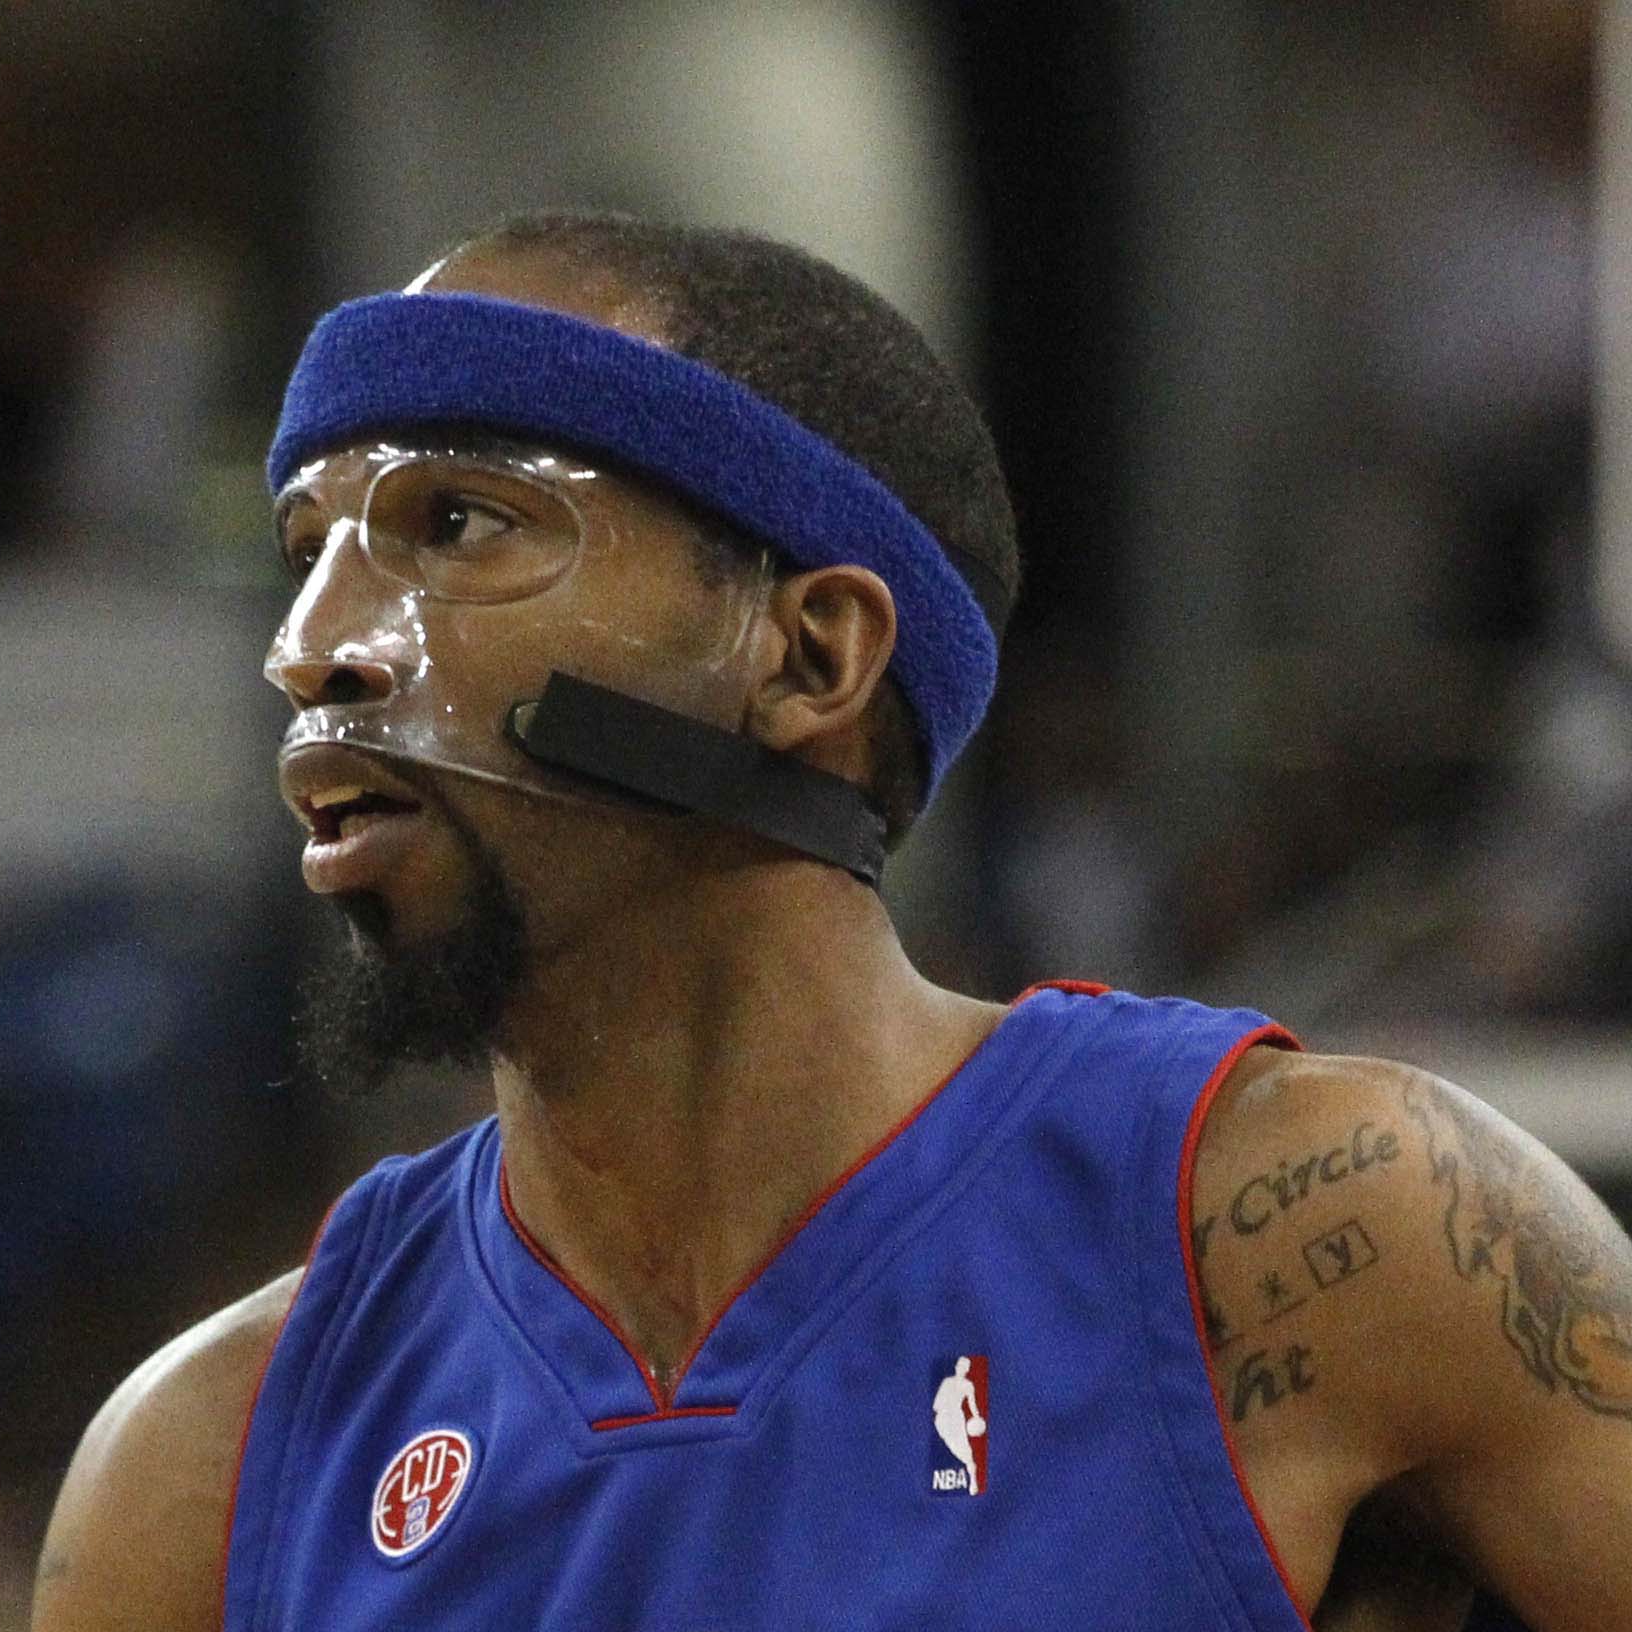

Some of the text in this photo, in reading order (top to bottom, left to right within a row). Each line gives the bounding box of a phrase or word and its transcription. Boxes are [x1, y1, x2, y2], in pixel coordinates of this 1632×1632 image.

[1231, 1121, 1401, 1236] Circle
[401, 1440, 449, 1503] CD
[932, 1467, 967, 1490] NBA
